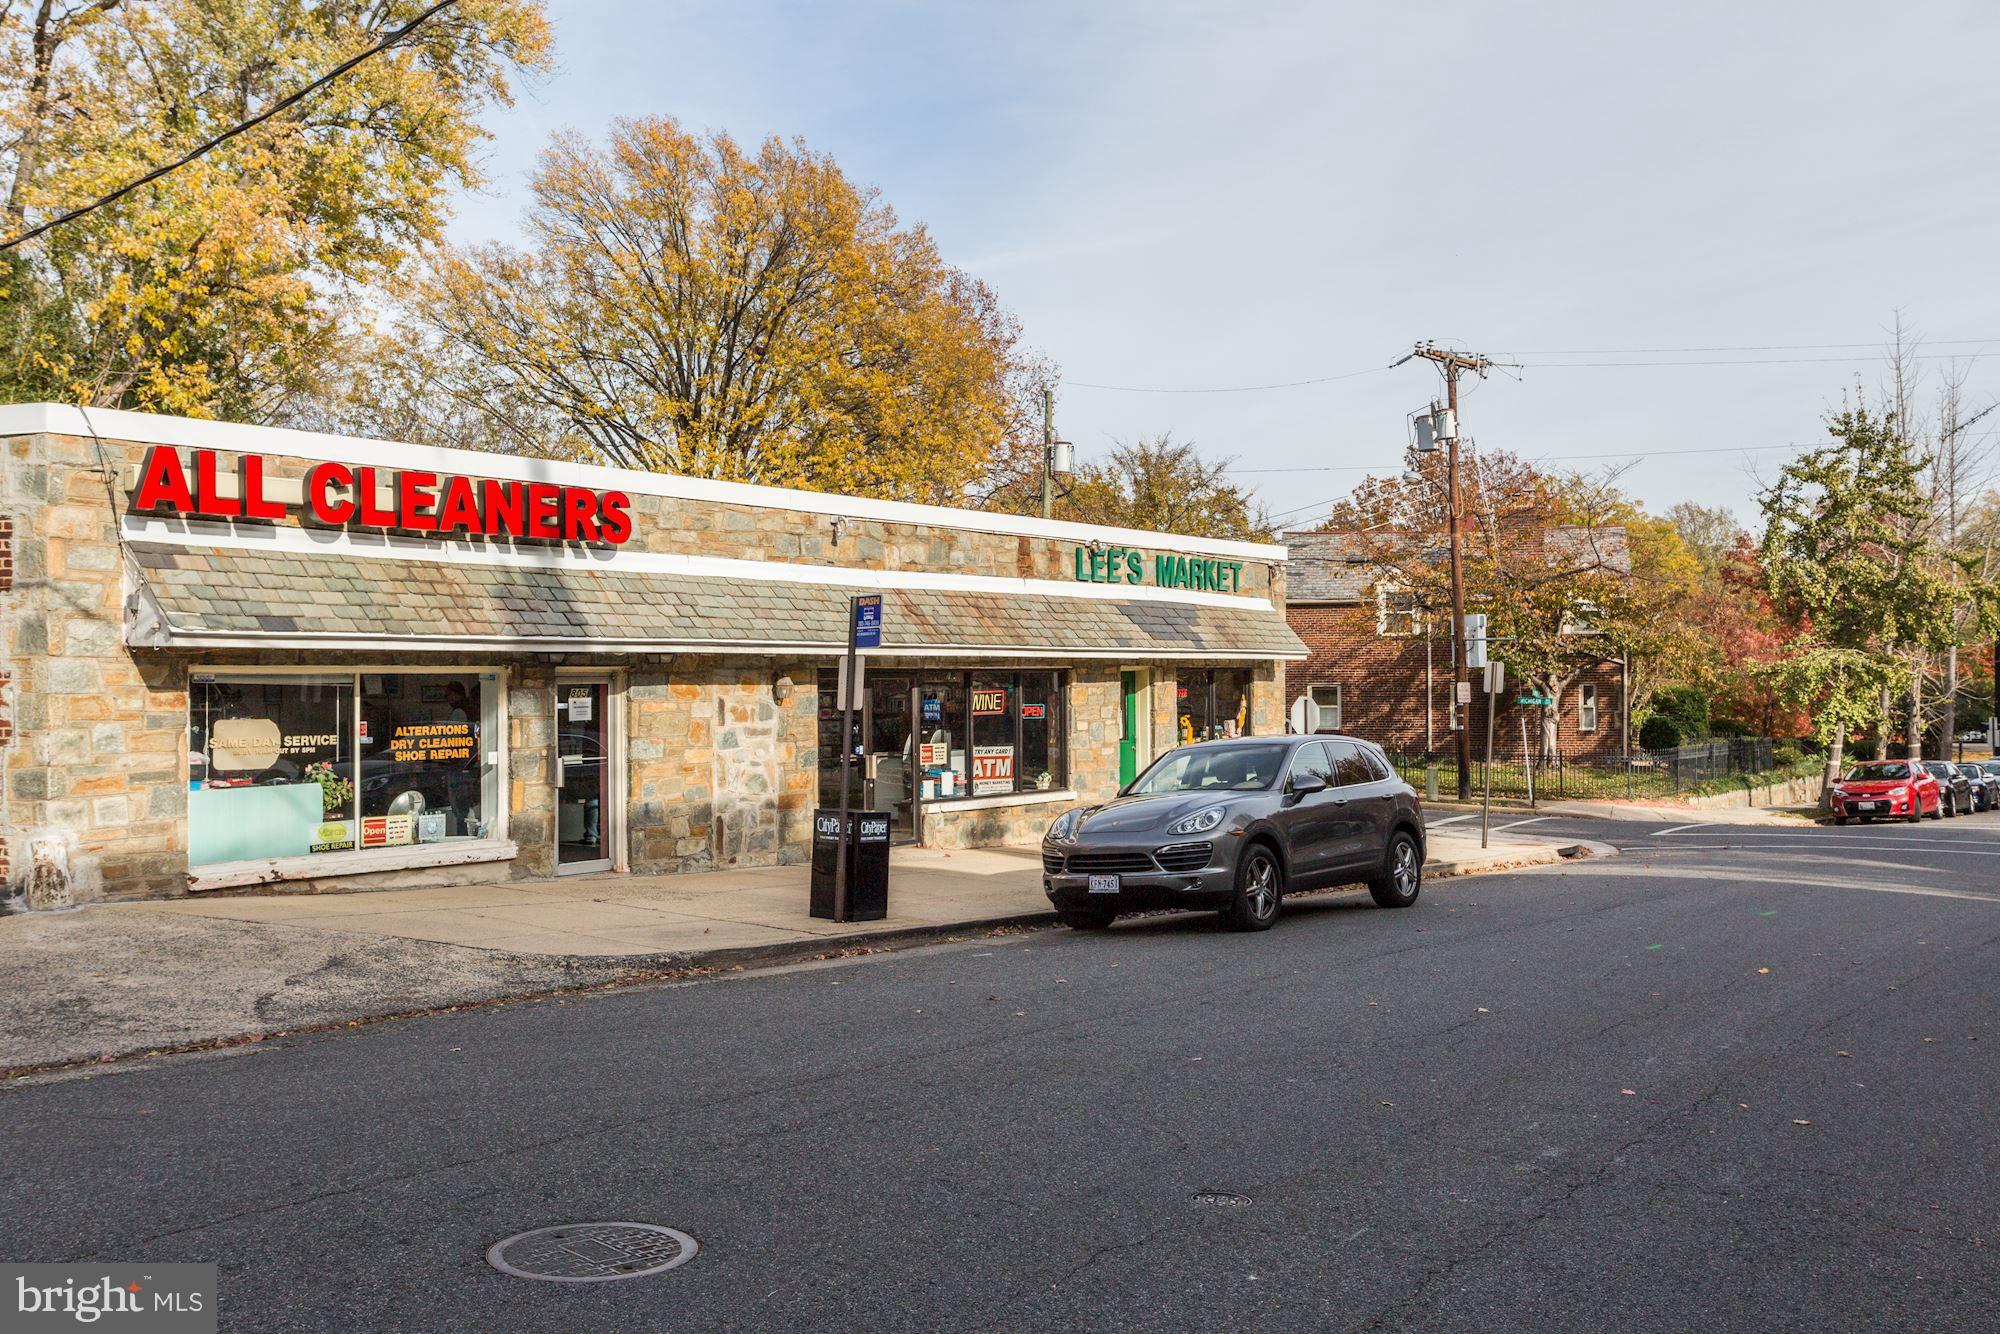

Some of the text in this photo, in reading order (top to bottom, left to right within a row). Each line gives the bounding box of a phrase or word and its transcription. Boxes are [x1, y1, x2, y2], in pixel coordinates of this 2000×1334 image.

[136, 445, 632, 544] ALL CLEANERS
[1075, 546, 1243, 593] LEE'S MARKET
[858, 597, 880, 606] DASH
[570, 689, 587, 697] 805
[924, 703, 941, 711] ATM
[395, 724, 469, 737] ALTERATIONS
[284, 734, 337, 747] SERVICE
[390, 737, 474, 750] DRY CLEANING
[395, 748, 470, 761] SHOE REPAIR
[973, 758, 1011, 778] ATM
[364, 826, 386, 836] Open
[861, 821, 887, 836] CityPaper
[312, 841, 353, 852] SHOE REPAIR
